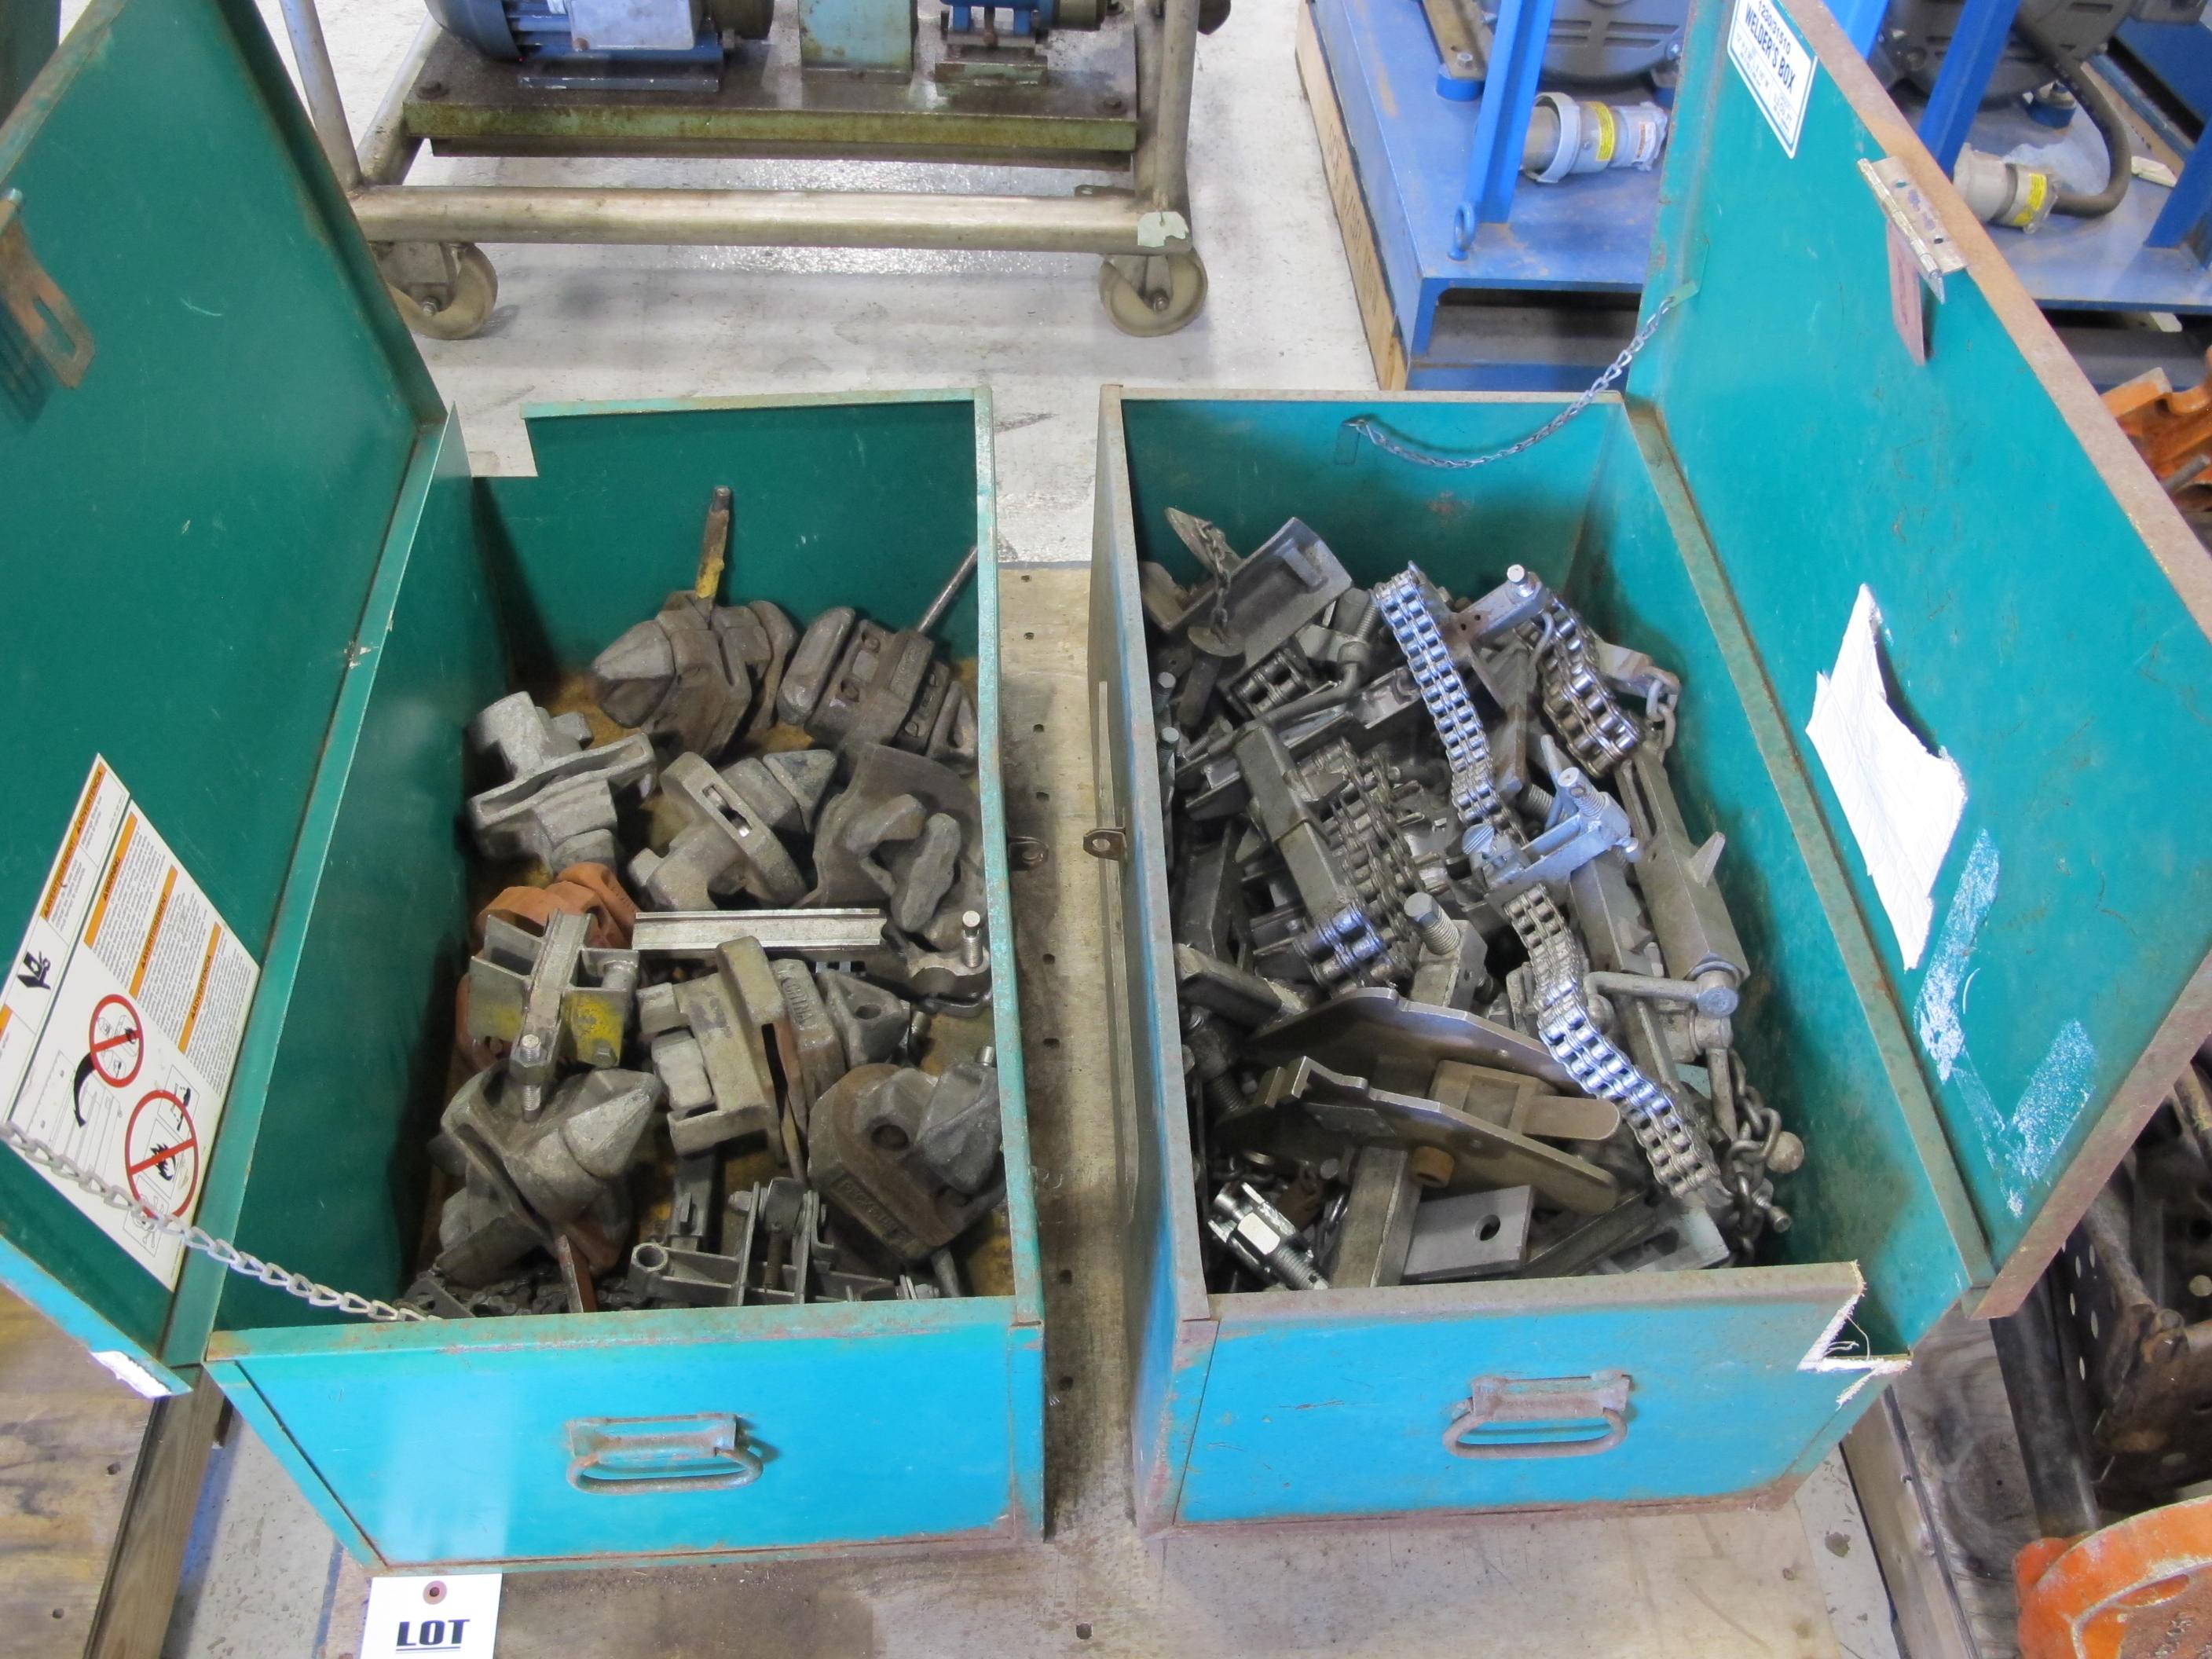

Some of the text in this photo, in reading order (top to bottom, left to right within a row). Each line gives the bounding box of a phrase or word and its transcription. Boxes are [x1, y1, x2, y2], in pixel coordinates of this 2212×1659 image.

[1745, 2, 1779, 68] WELDER'S
[1778, 56, 1796, 93] BOX
[79, 771, 103, 828] ADVERTENCIA
[105, 856, 121, 894] WARNING
[142, 893, 167, 961] AVERTISSEMENT
[192, 954, 211, 1013] ADVERTENCIA
[396, 1619, 471, 1646] LOT
